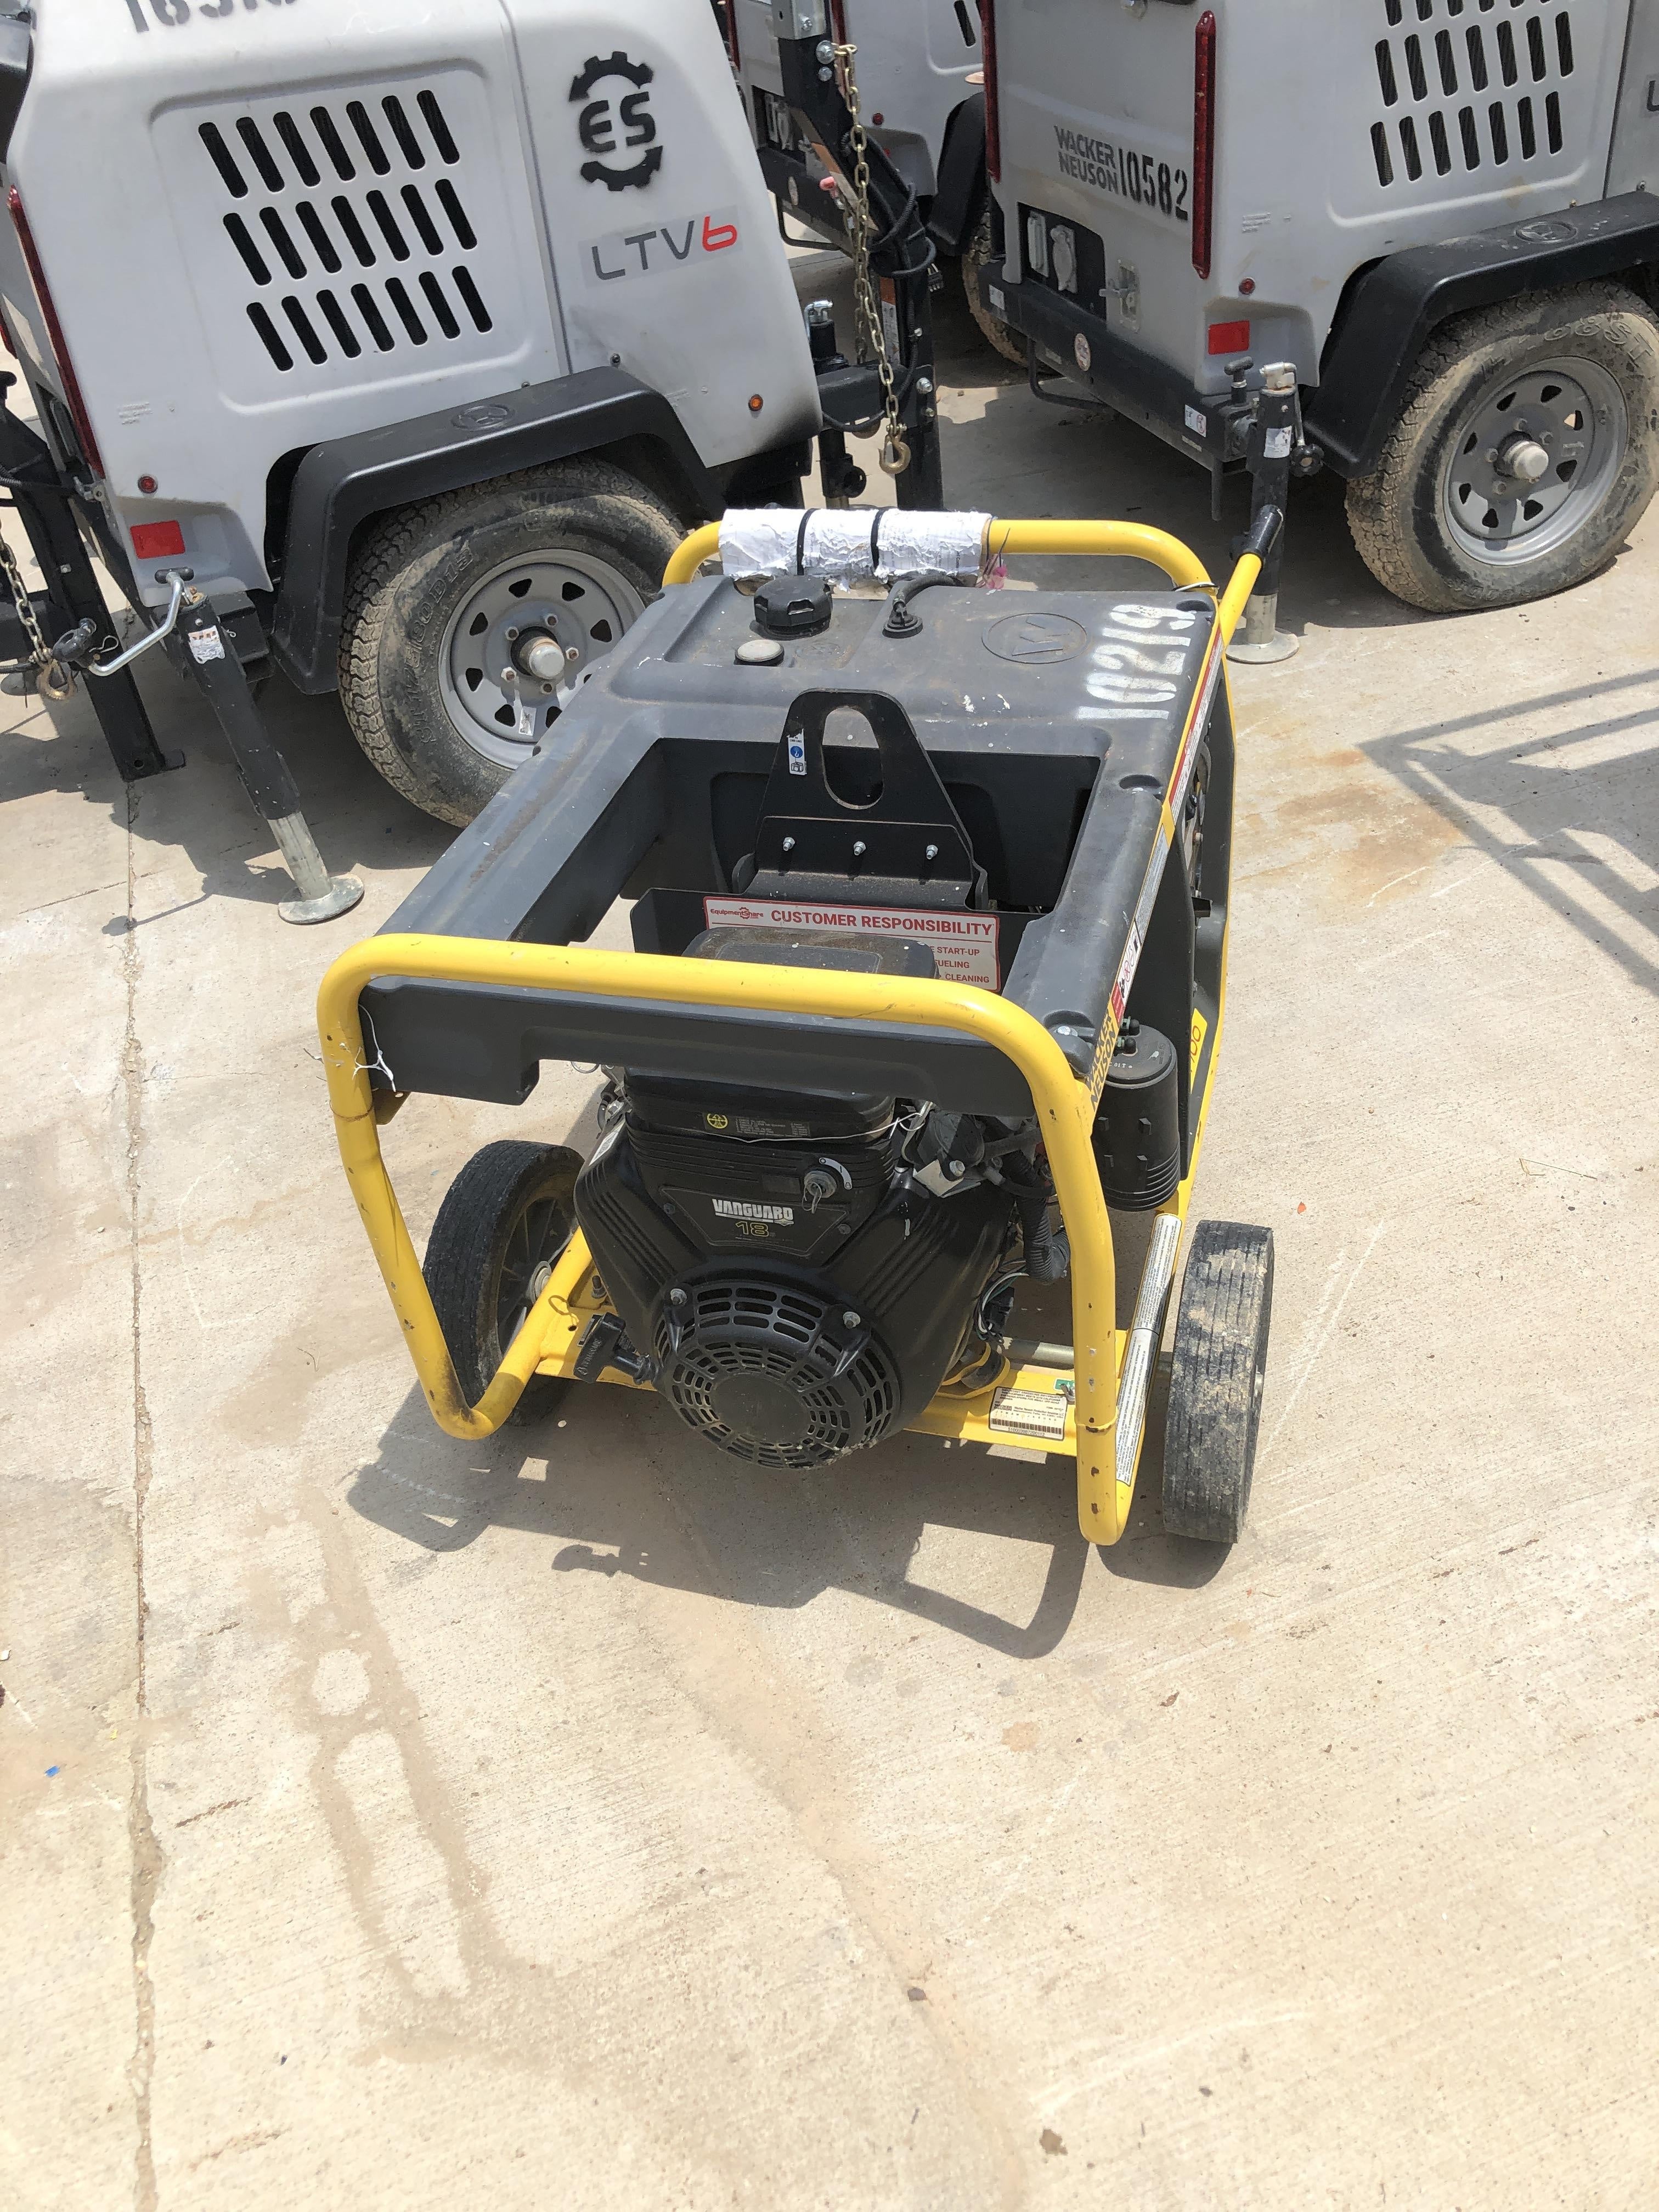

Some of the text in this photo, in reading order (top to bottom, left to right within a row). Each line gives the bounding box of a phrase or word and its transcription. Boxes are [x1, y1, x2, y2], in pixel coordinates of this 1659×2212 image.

[1053, 125, 1117, 170] WACKER
[1058, 150, 1119, 194] NEUSON
[1118, 148, 1188, 221] 10582
[1077, 605, 1196, 720] 10219
[771, 910, 857, 927] CUSTOMER
[861, 916, 992, 935] RESPONSIBILITY
[936, 946, 980, 956] START-UP
[945, 973, 990, 983] CLEANING
[712, 1199, 793, 1220] VANGUARD
[736, 1221, 769, 1237] 18
